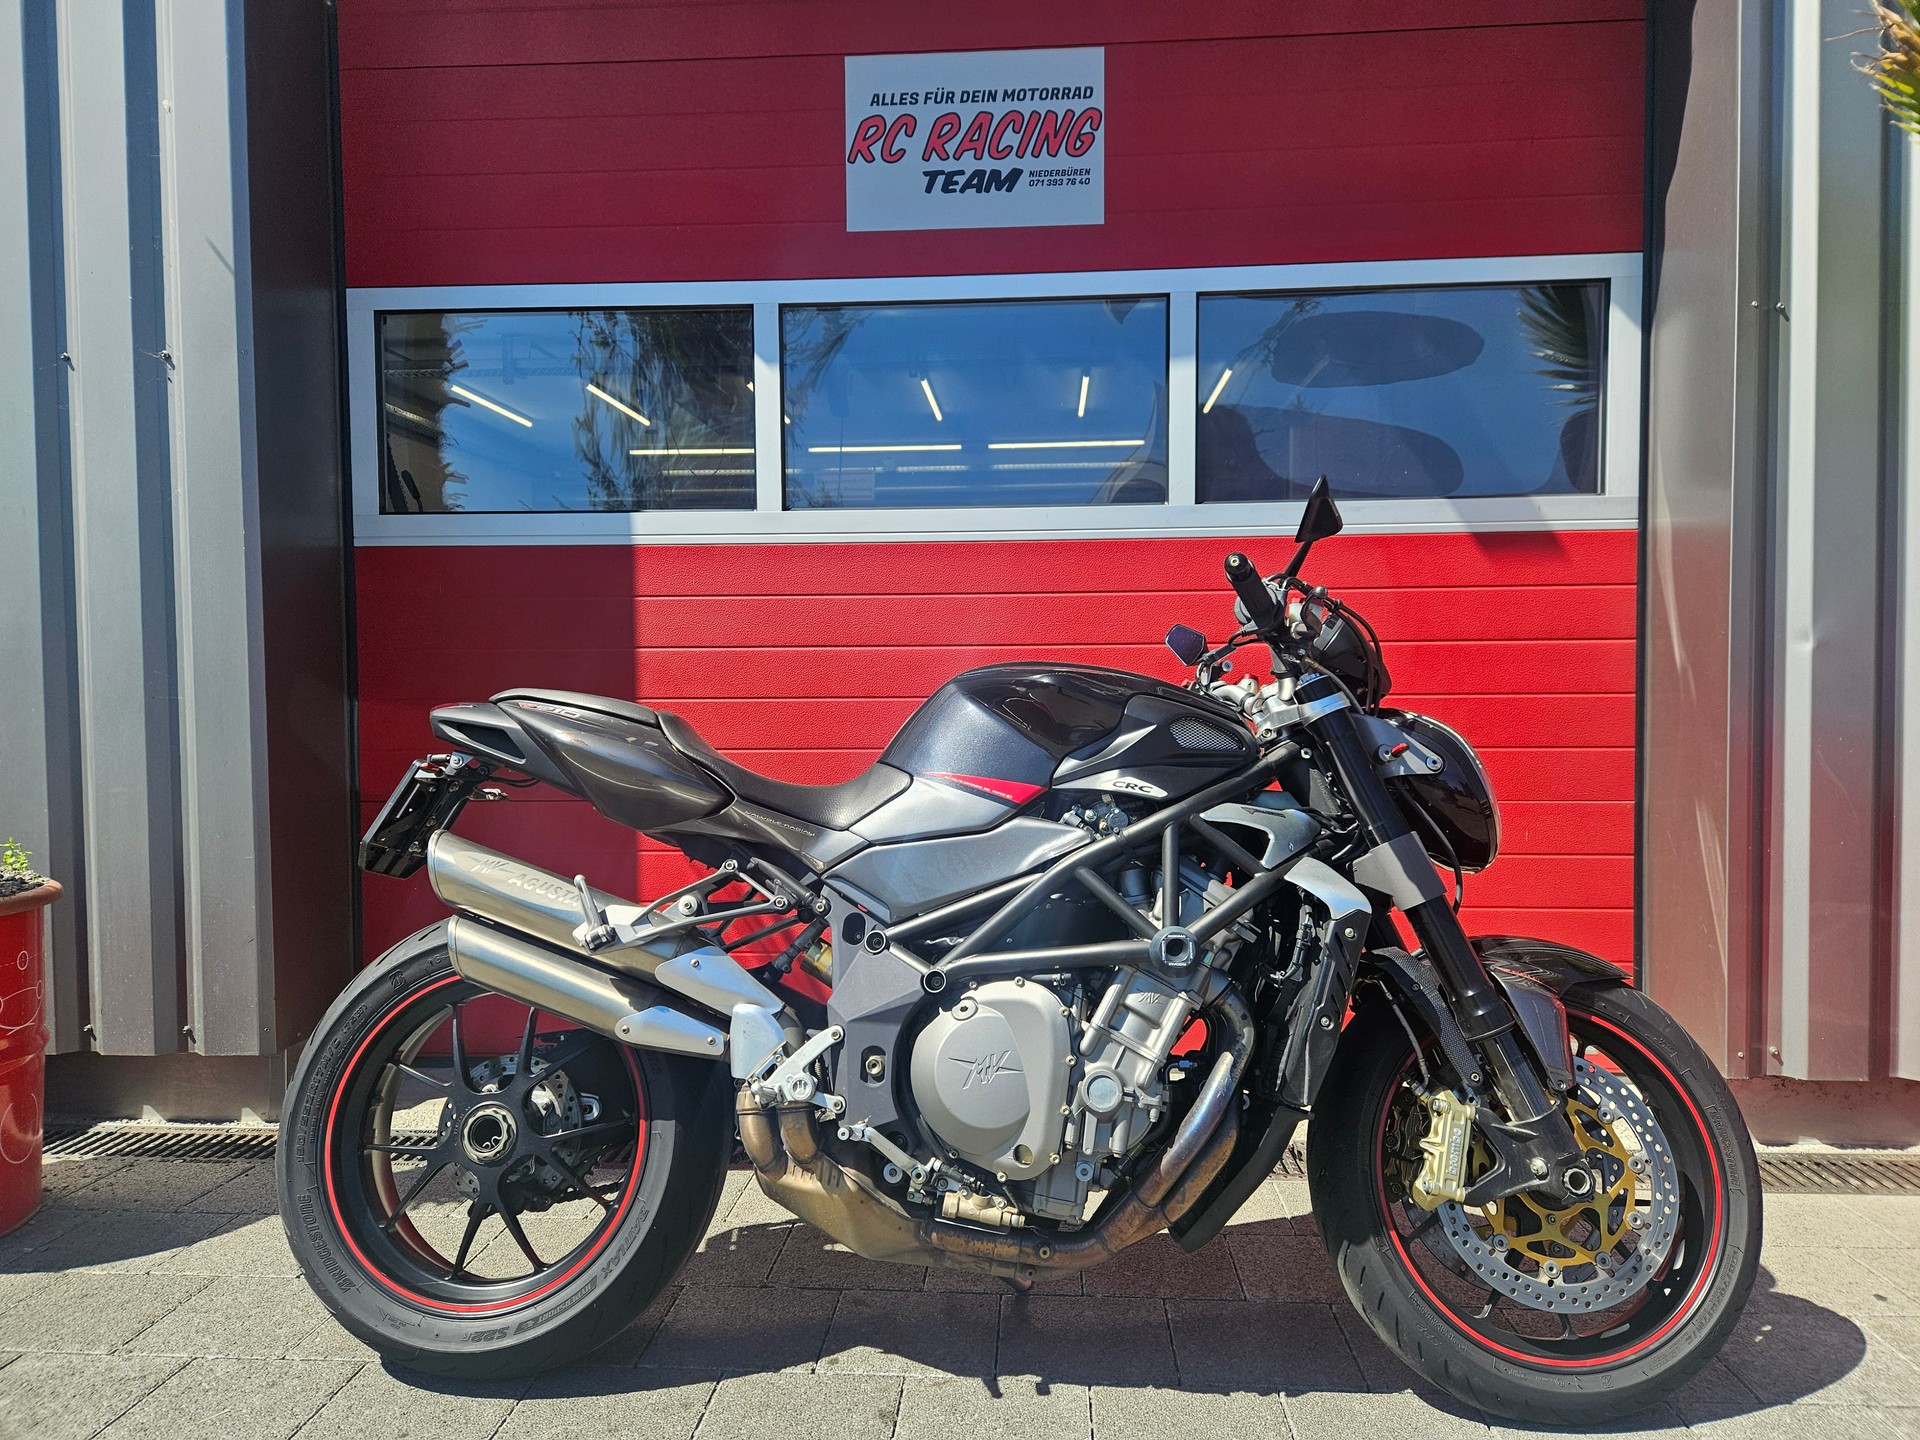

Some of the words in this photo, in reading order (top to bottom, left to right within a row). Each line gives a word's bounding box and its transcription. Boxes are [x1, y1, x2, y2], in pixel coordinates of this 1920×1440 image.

[870, 92, 919, 106] ALLES
[923, 87, 956, 105] FÜR
[959, 89, 998, 104] DEIN
[1001, 86, 1094, 102] MOTORRAD
[847, 113, 917, 164] RC
[921, 107, 1102, 162] RACING
[922, 167, 1024, 194] TEAM
[1028, 166, 1091, 178] NIEDERBÜREN
[1028, 178, 1045, 187] 071
[1046, 178, 1063, 187] 393
[1065, 177, 1076, 187] 76
[1078, 177, 1091, 186] 40
[1112, 780, 1154, 794] CRC
[1446, 1127, 1462, 1176] brembo
[297, 1193, 357, 1293] BRIDGESTONE
